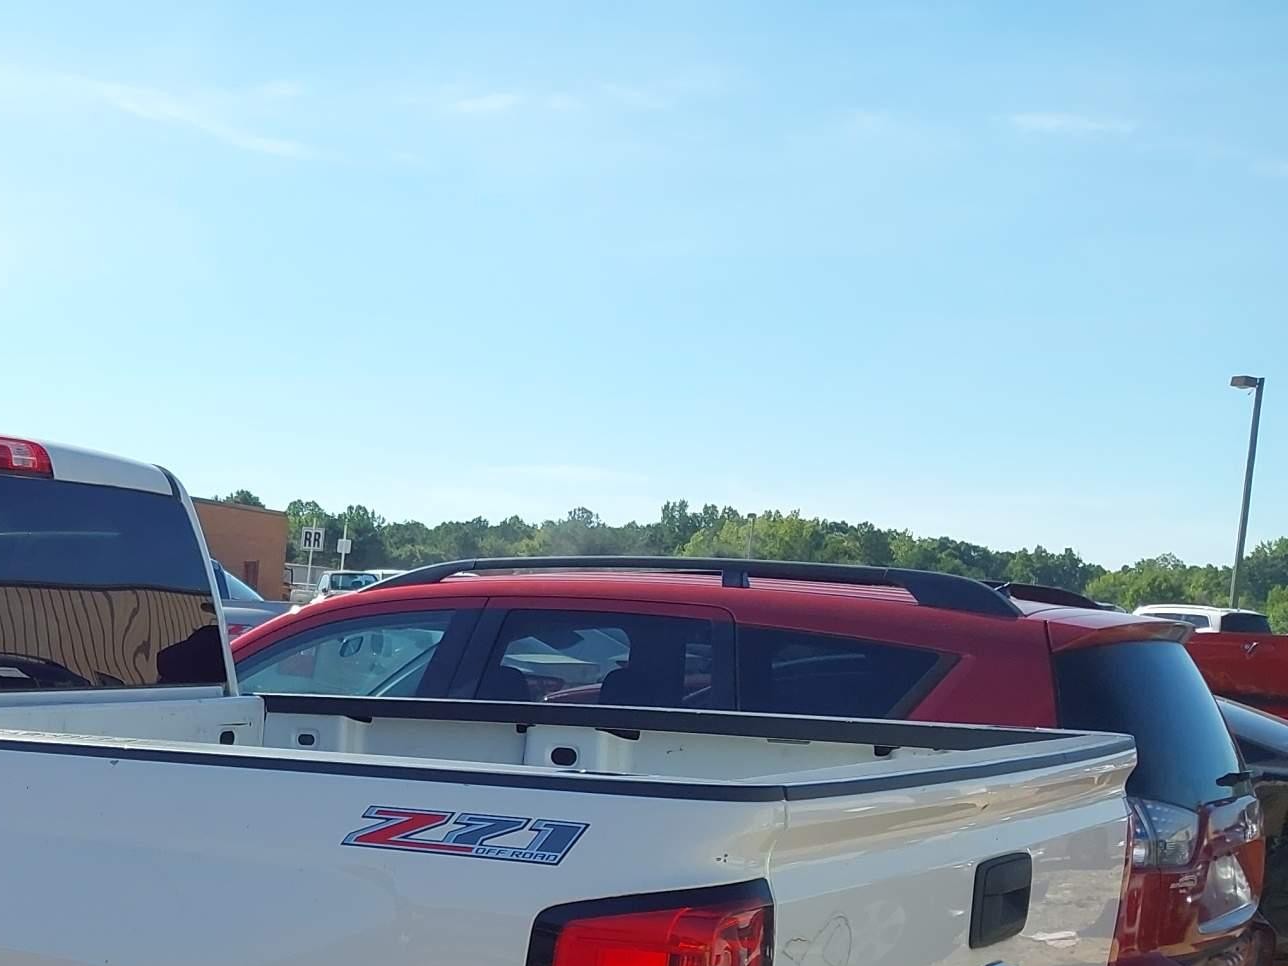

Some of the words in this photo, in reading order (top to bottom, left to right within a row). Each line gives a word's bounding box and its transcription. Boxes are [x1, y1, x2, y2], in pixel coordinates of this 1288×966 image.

[303, 531, 321, 548] RR
[341, 805, 590, 864] Z71
[475, 847, 508, 857] OFF
[510, 850, 559, 862] ROAD
